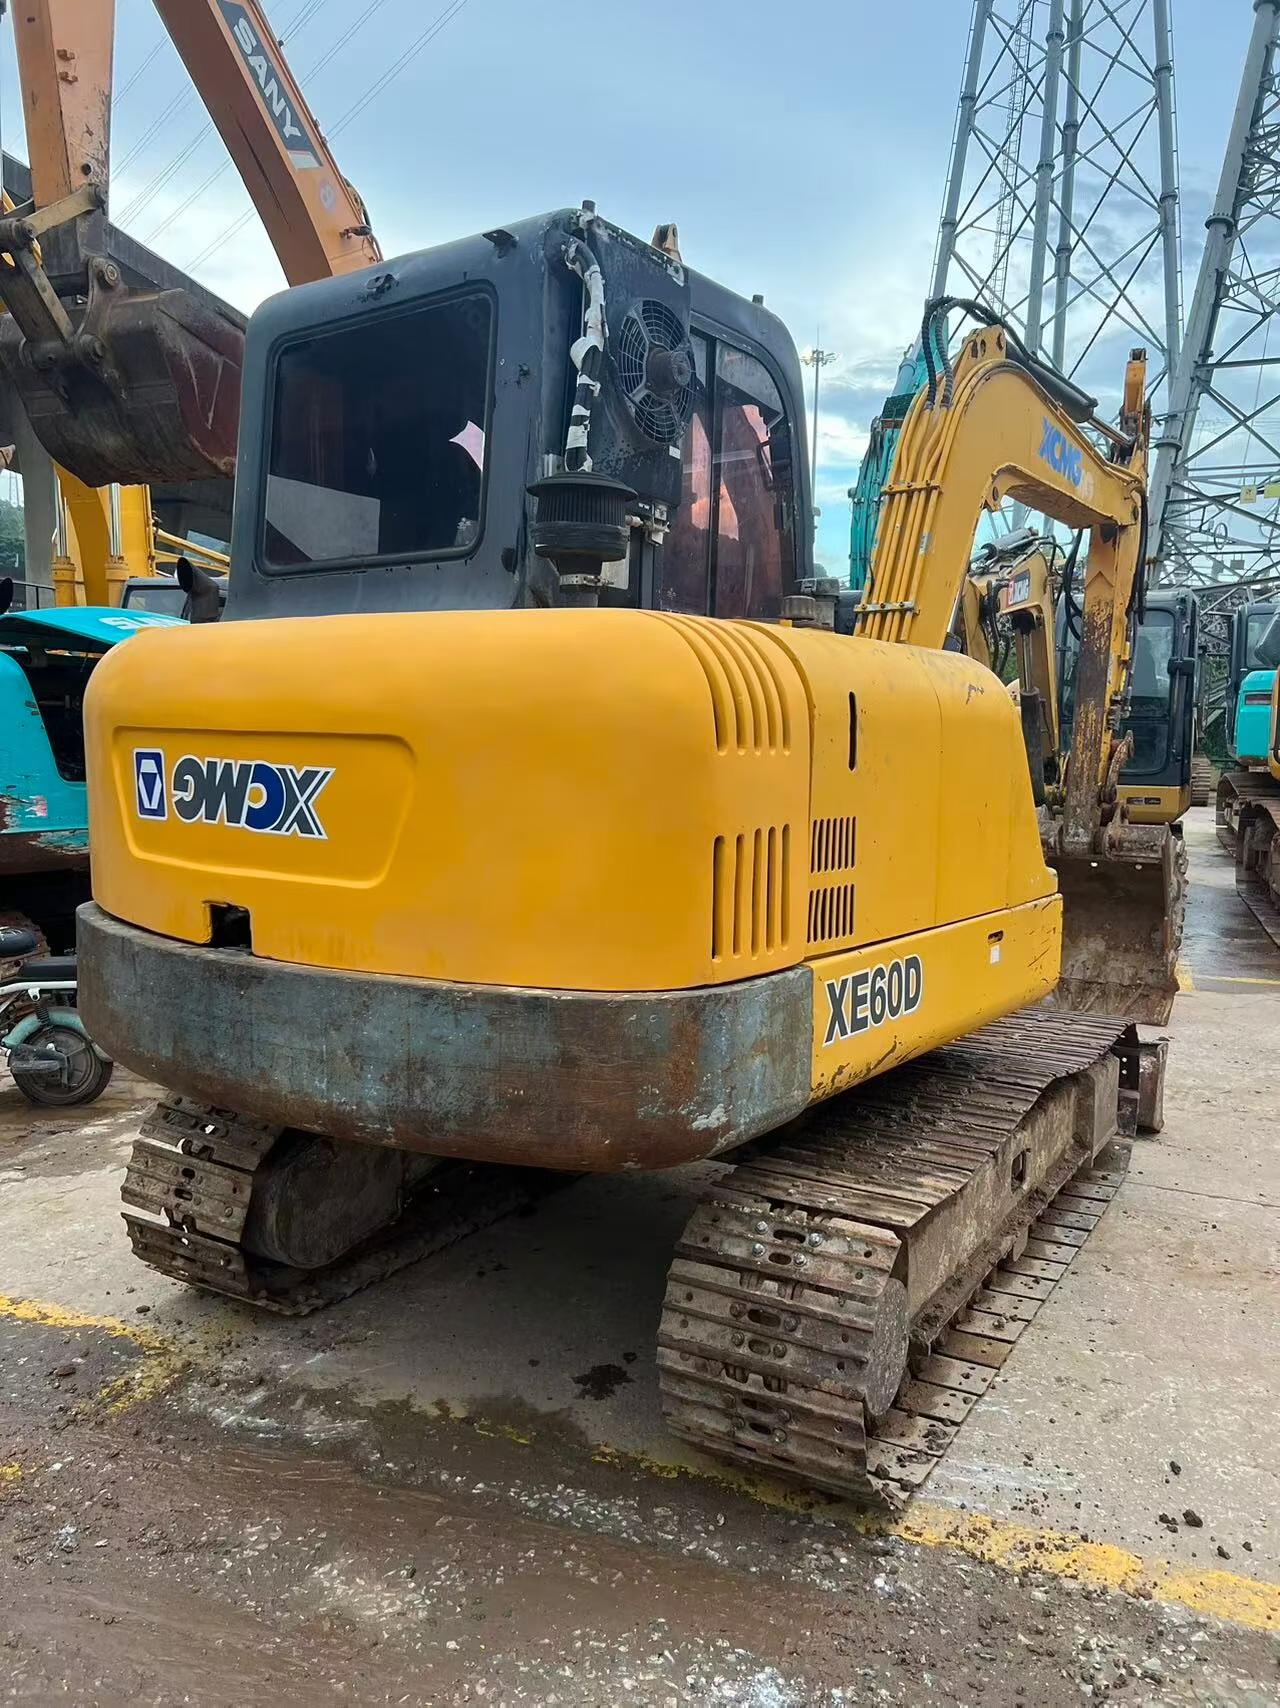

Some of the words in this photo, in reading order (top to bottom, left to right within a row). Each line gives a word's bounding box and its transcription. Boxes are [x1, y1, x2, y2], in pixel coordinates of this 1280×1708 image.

[233, 17, 301, 138] SANY
[1037, 416, 1082, 487] XCMG
[173, 755, 336, 840] XCMG
[823, 954, 922, 1046] XE60D
